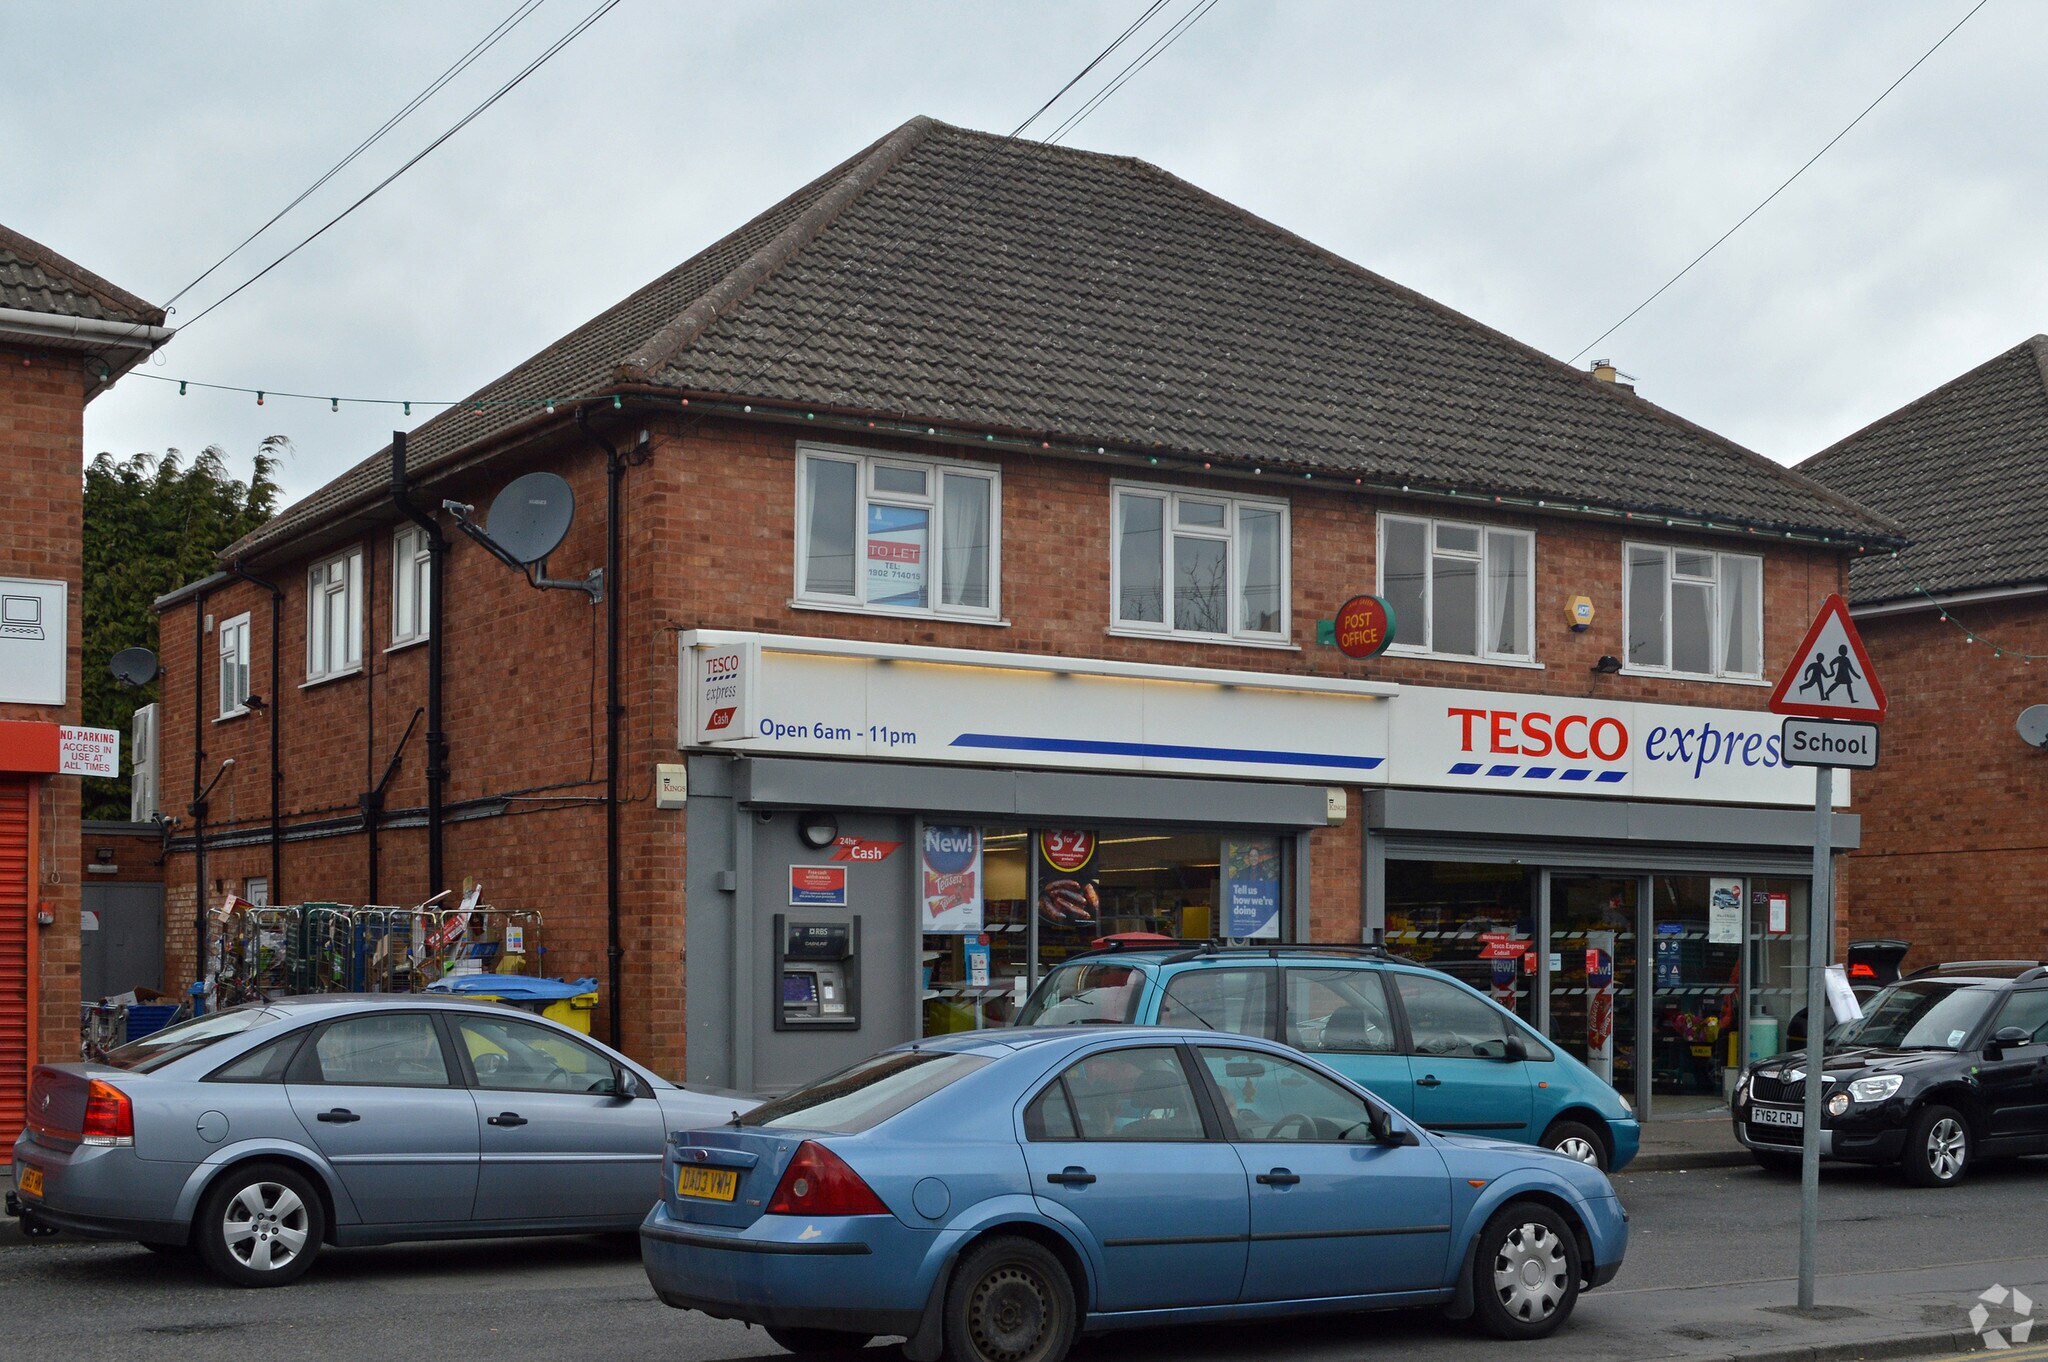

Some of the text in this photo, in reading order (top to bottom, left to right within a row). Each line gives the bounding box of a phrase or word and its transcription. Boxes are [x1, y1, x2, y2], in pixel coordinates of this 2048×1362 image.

[869, 545, 919, 559] TO LET
[1345, 612, 1373, 630] POST
[1342, 628, 1378, 647] OFFICE
[706, 655, 739, 674] TESCO
[706, 685, 736, 704] express
[713, 712, 729, 725] Cash
[60, 730, 115, 744] NO PARKING
[759, 718, 808, 740] Open
[813, 722, 851, 740] 6am
[869, 726, 916, 747] 11pm
[63, 743, 100, 753] ACCESS
[1447, 707, 1794, 779] TESCO expres
[1792, 730, 1867, 755] School
[71, 752, 103, 762] USE AT
[64, 761, 110, 772] ALL TIMES
[840, 837, 857, 845] 24hr
[925, 831, 973, 853] New!
[1050, 830, 1063, 851] 3
[1072, 831, 1085, 852] 2
[851, 846, 882, 860] Cash
[1233, 884, 1247, 894] Tell
[1233, 895, 1274, 905] how we're
[1233, 905, 1257, 917] doing
[1755, 1109, 1799, 1125] FY62 CRJ
